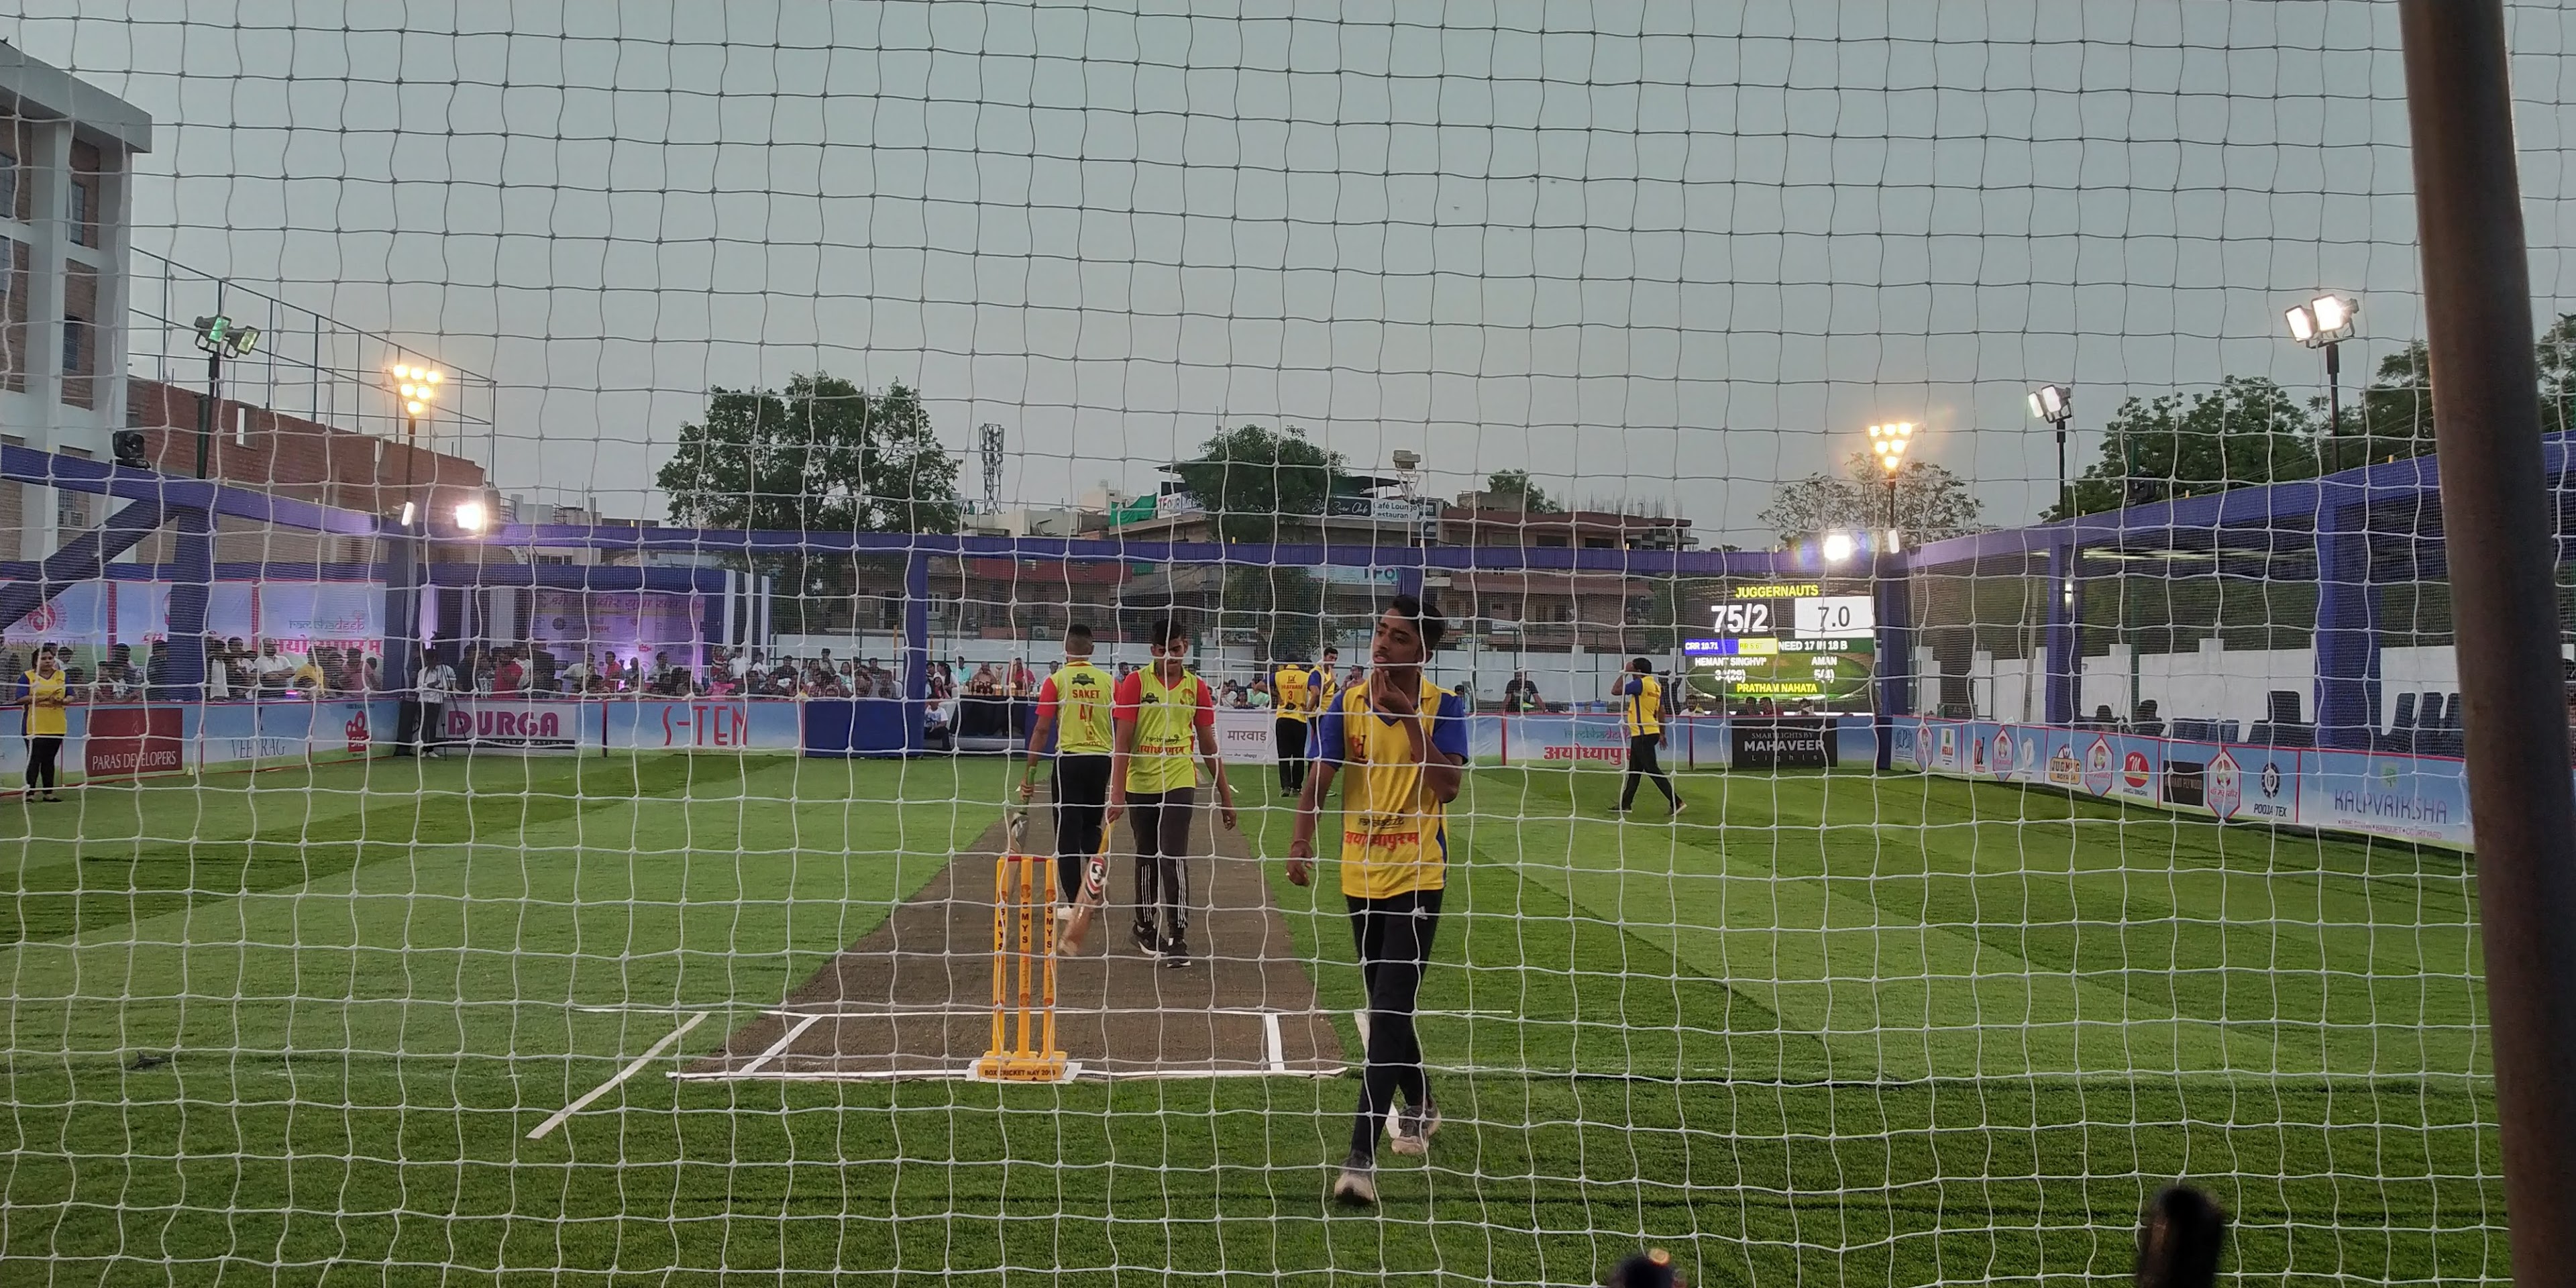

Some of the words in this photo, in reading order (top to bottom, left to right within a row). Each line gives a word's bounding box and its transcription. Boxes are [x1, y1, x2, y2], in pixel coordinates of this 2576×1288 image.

[1373, 511, 1411, 519] estauran
[1735, 584, 1819, 598] JUGGERNAUTS
[1711, 602, 1768, 633] 75/2
[1817, 605, 1851, 627] 7.0
[1778, 641, 1803, 651] NEED
[1805, 641, 1815, 650] 17
[1840, 641, 1848, 650] B
[1811, 656, 1837, 665] AMAN
[1072, 689, 1101, 698] SAKET
[1288, 690, 1293, 700] 3
[1737, 683, 1780, 693] PRATHAM
[1781, 683, 1818, 693] NAHATA
[447, 710, 559, 737] DURGA
[661, 705, 748, 746] S-TEN
[231, 738, 286, 759] VEERAG
[1744, 739, 1824, 751] MAHAVEER
[92, 754, 121, 771] PARAS
[123, 750, 176, 768] DEVELOPERS
[2253, 803, 2273, 816] POOJA
[2275, 805, 2288, 817] TEX
[2334, 788, 2447, 824] KALPVRIKSHA
[1046, 906, 1054, 949] SMYS
